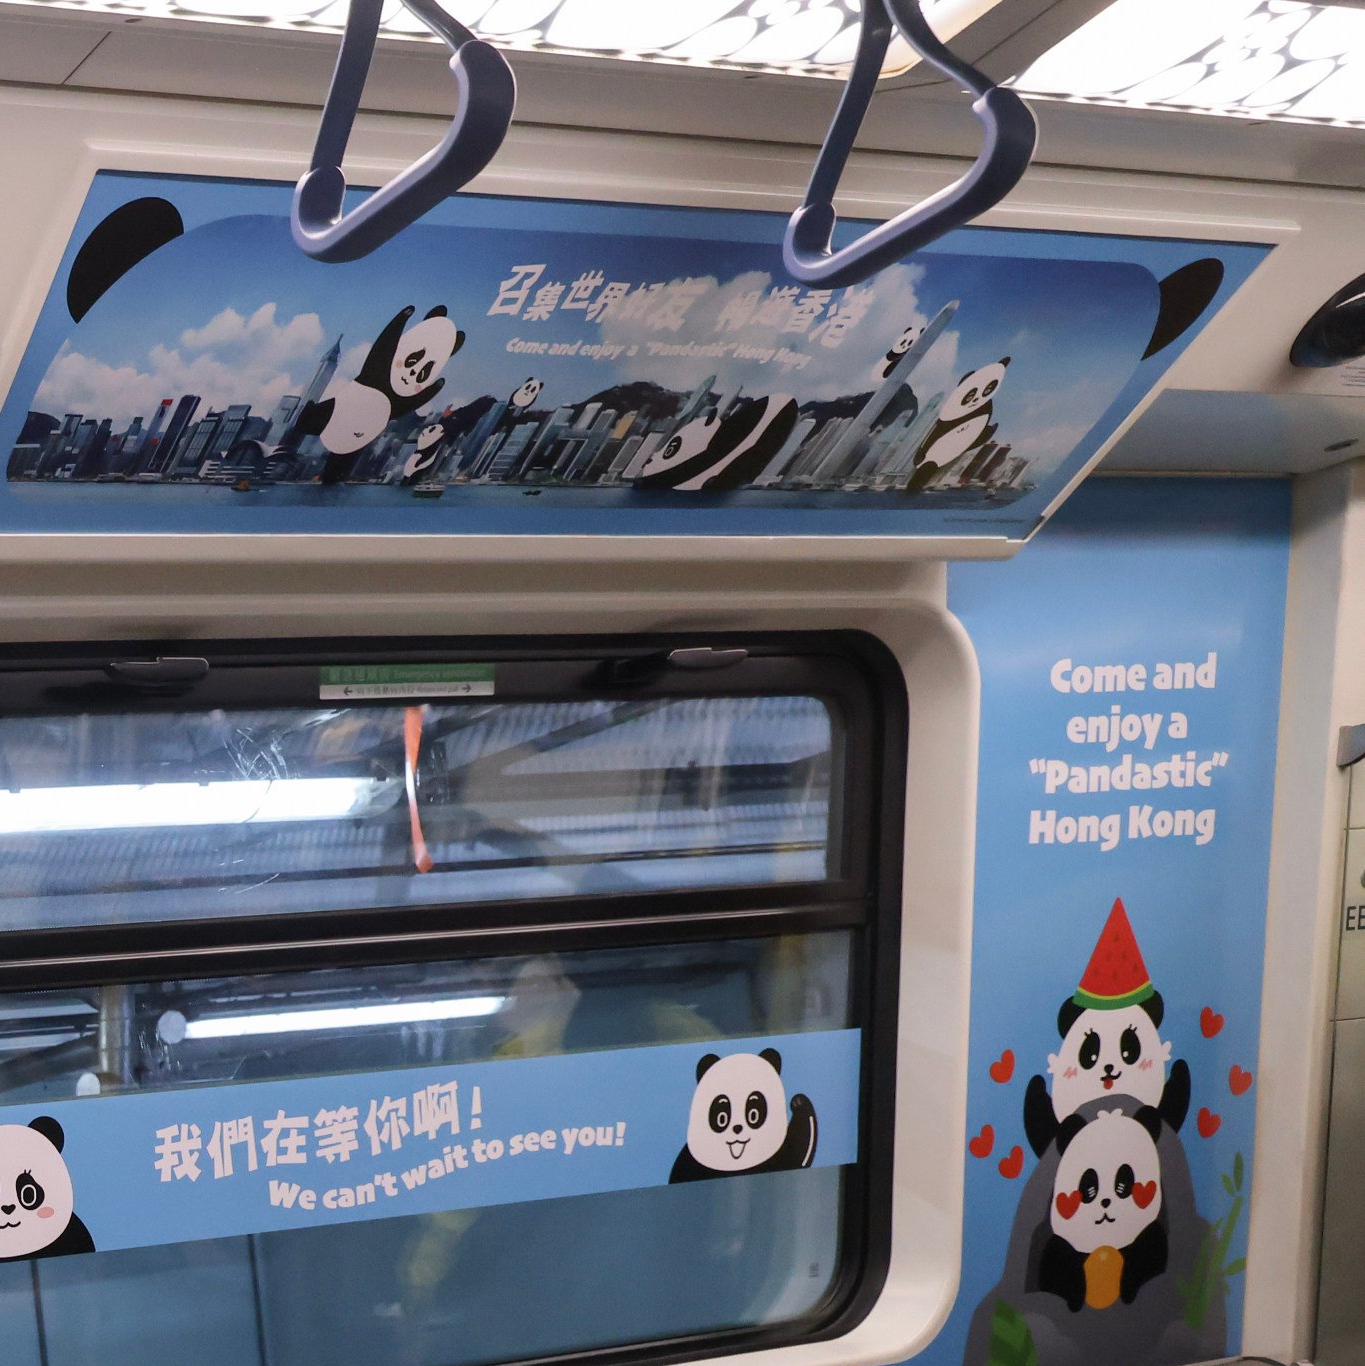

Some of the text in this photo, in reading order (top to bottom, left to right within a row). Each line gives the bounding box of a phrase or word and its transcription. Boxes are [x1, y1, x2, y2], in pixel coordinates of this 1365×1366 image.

[506, 337, 548, 354] Come
[548, 340, 583, 355] and
[580, 341, 624, 360] enjoy
[1050, 652, 1218, 694] Come and
[1066, 705, 1188, 753] enjoy a
[1029, 751, 1229, 795] "Pandastic"
[1028, 804, 1216, 852] Hong Kong
[269, 1121, 626, 1211] We can't wait to see you!
